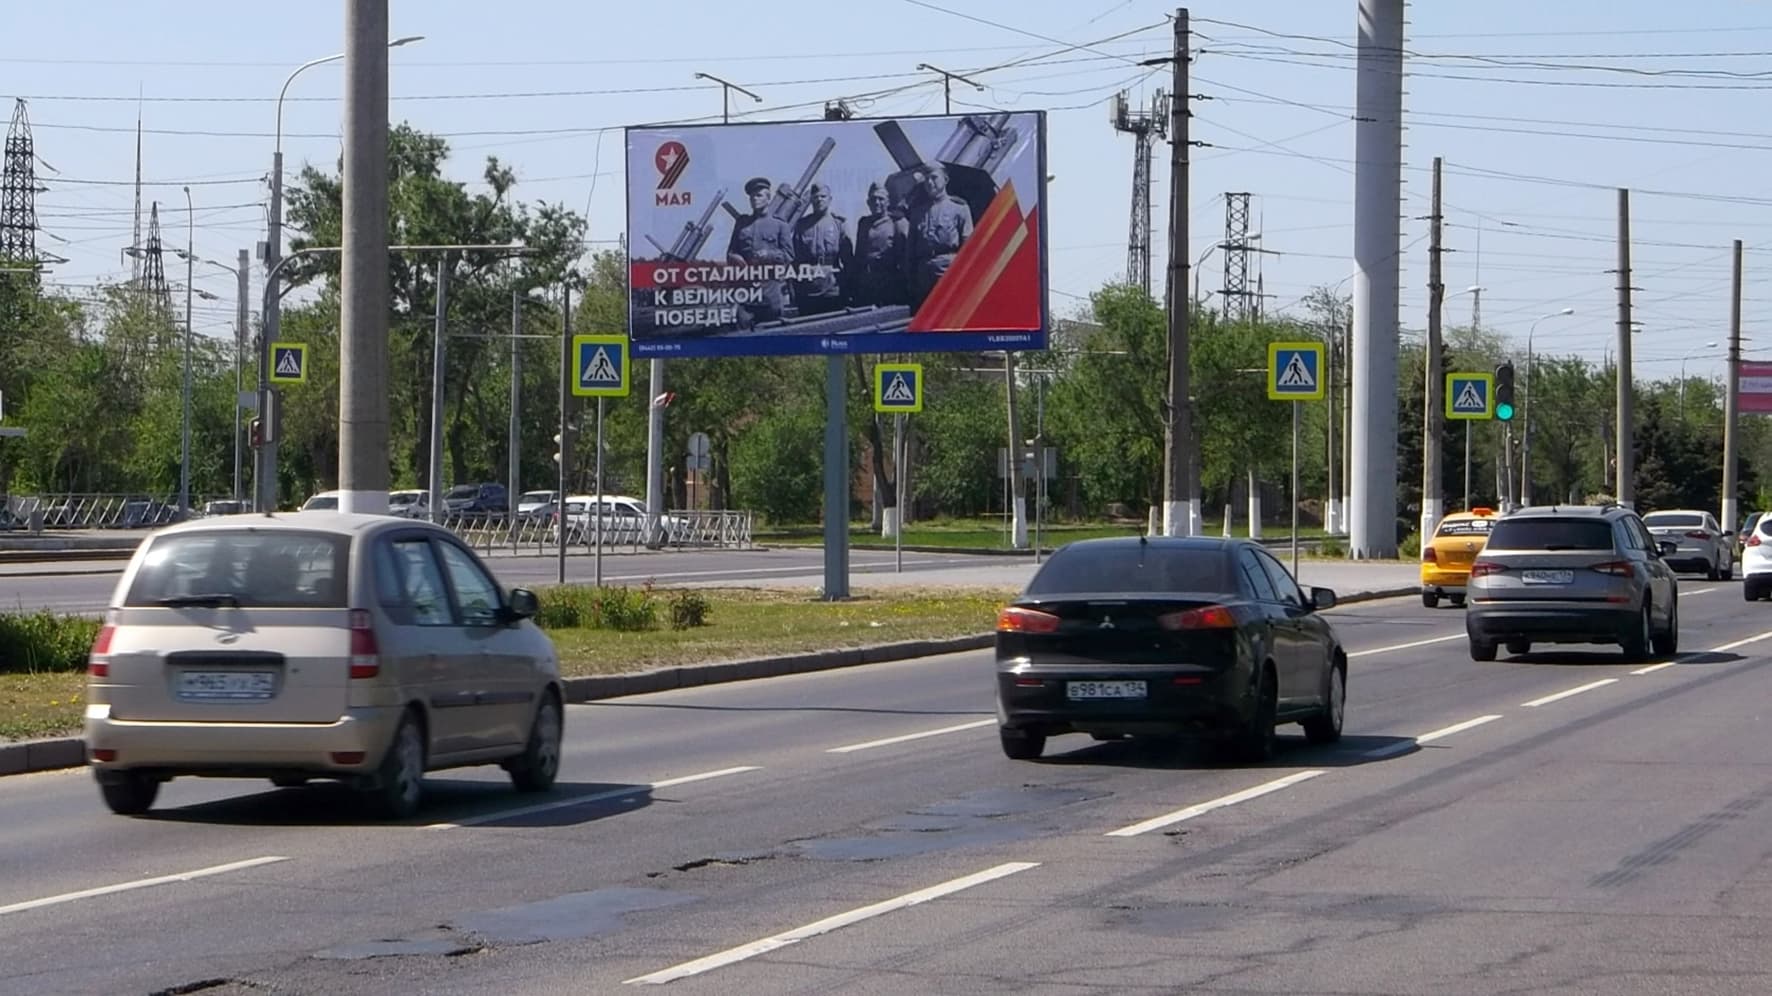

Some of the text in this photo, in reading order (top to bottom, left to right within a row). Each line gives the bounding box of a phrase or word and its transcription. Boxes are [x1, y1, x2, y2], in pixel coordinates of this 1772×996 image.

[655, 192, 691, 206] МАЯ
[653, 268, 680, 283] ОТ
[684, 264, 826, 282] СТАЛИНГРАДА
[655, 282, 763, 305] К ВЕЛИКОЙ
[655, 308, 738, 326] ПОБЕДЕ!
